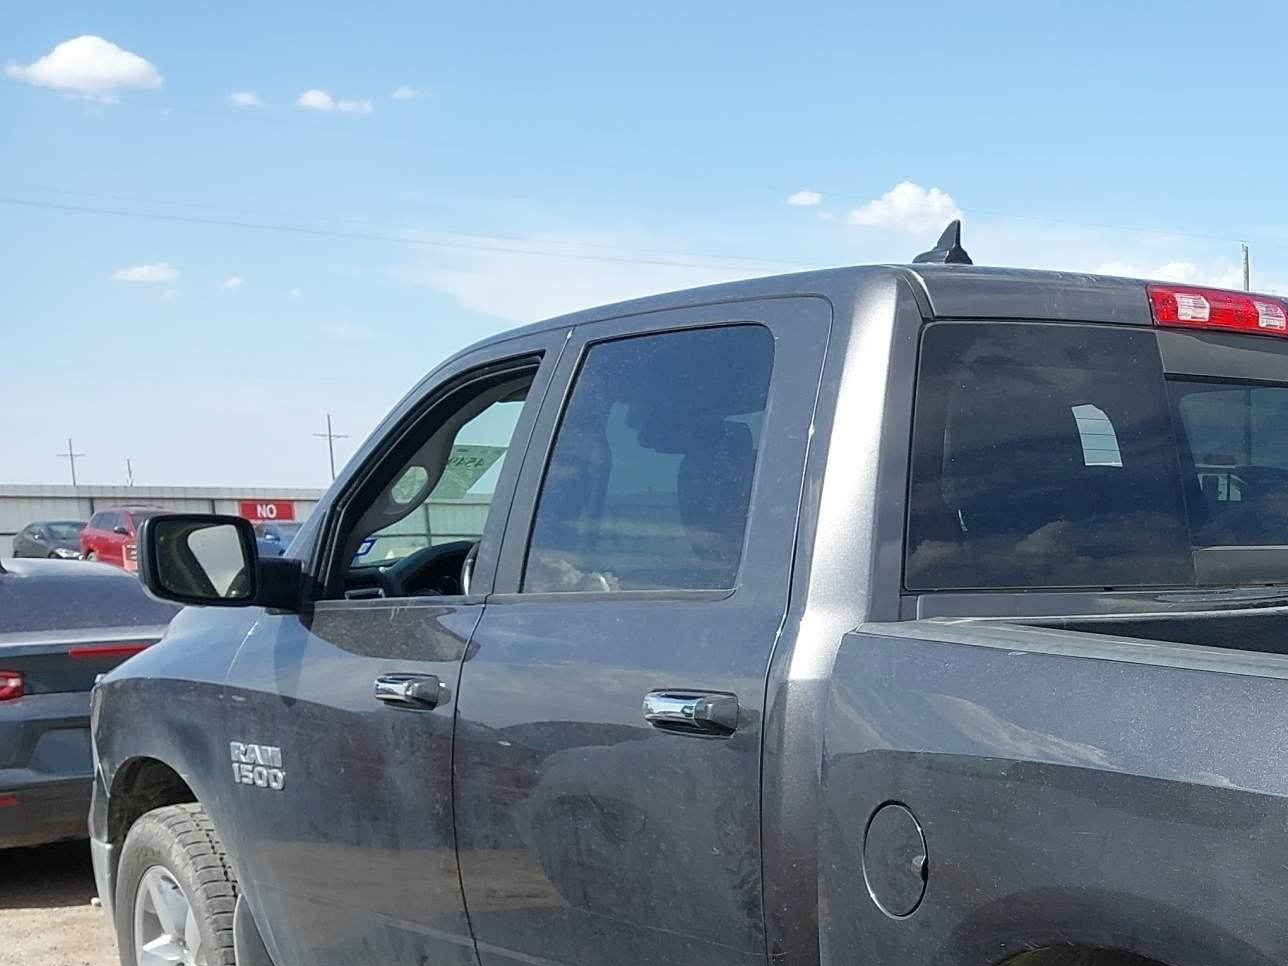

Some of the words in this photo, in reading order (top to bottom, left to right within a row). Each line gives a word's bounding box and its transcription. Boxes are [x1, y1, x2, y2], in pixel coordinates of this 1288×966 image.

[256, 503, 277, 519] NO
[230, 741, 282, 768] RAM
[232, 763, 286, 790] 1500
